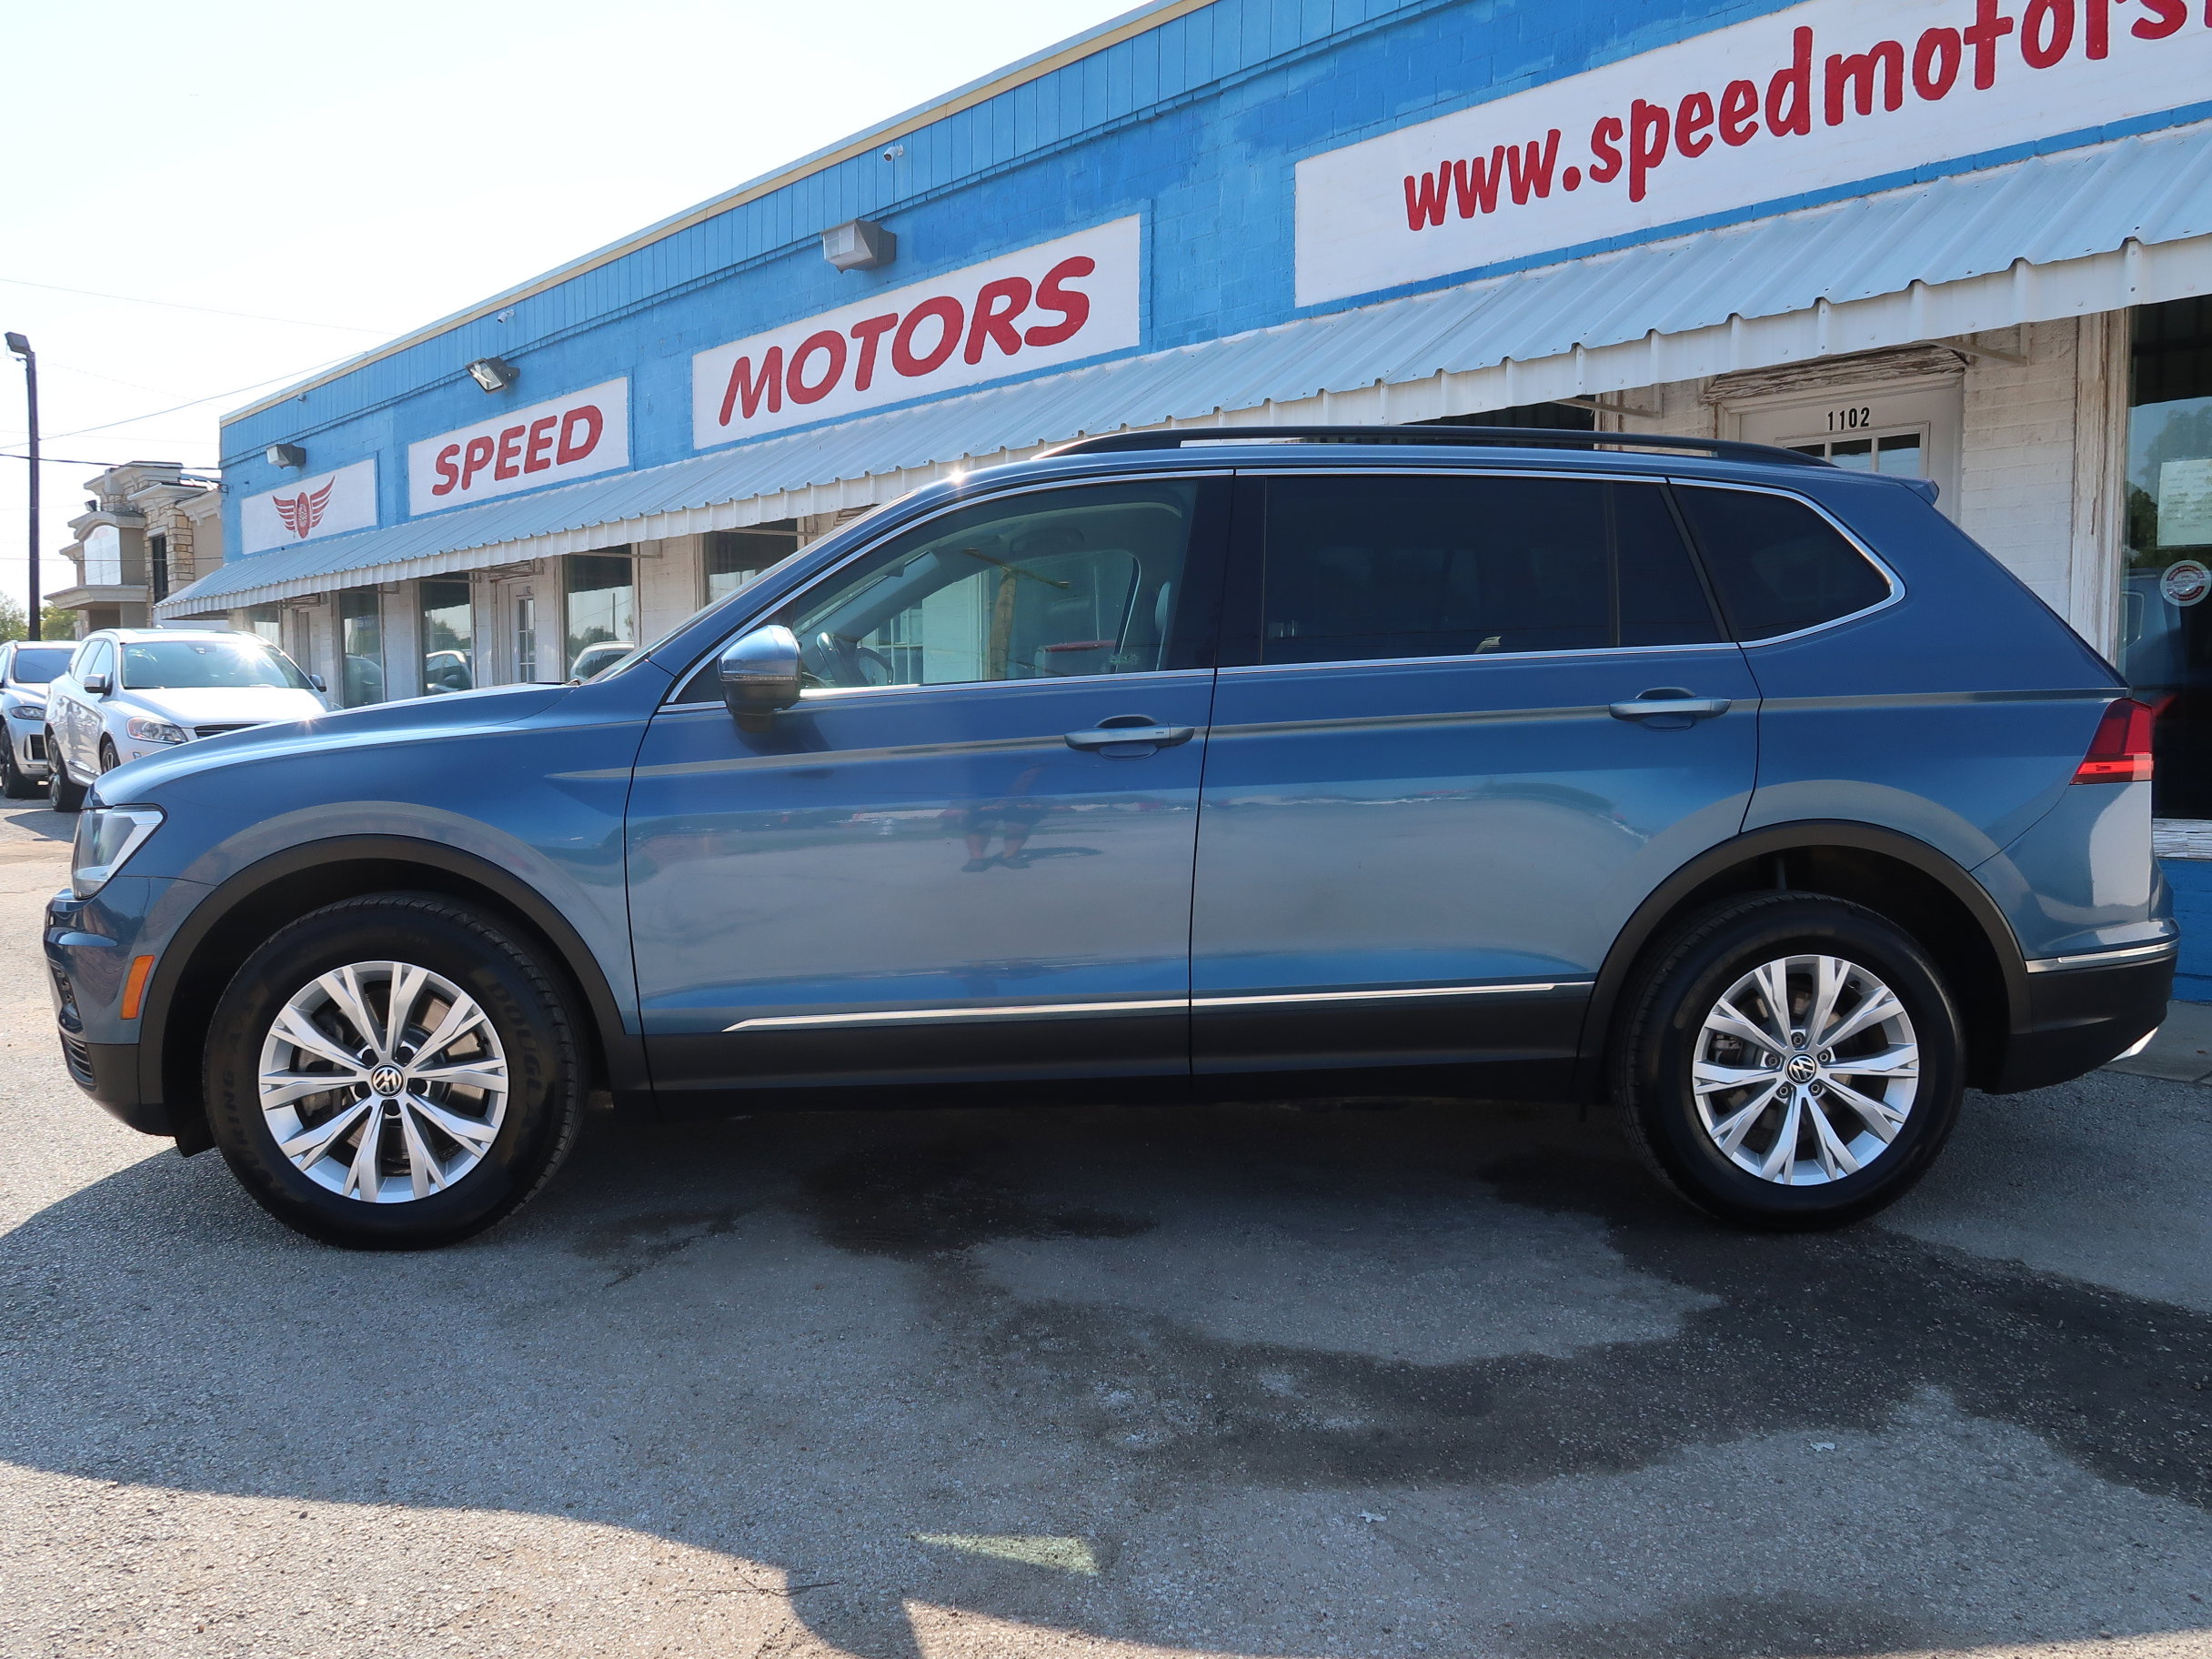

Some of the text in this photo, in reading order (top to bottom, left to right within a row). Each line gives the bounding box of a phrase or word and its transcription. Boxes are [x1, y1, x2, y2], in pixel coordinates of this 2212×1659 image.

[1403, 0, 2212, 232] www.speedmotors
[431, 256, 1096, 497] SPEED MOTORS
[1827, 407, 1870, 431] 1102
